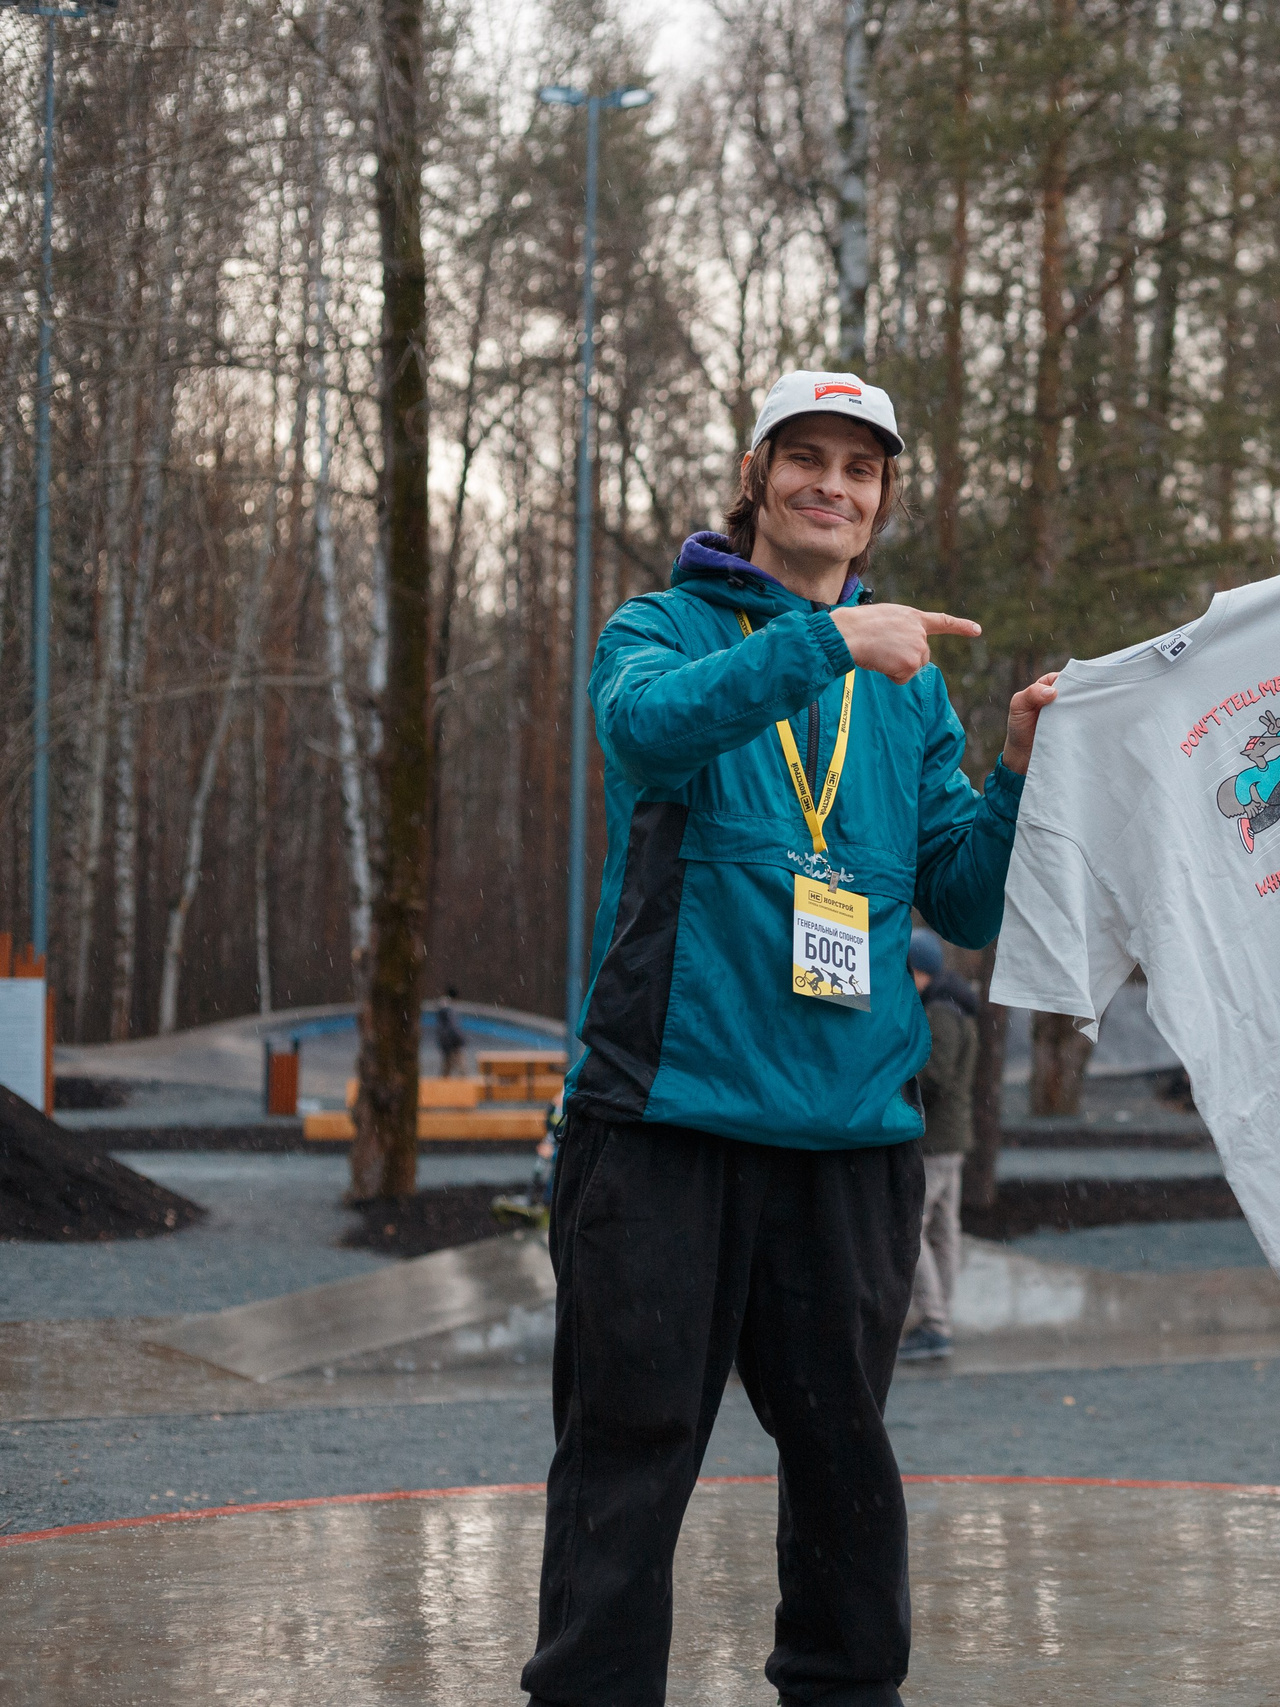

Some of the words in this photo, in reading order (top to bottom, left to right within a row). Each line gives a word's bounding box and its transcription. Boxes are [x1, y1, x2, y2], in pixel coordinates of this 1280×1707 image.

[1180, 706, 1221, 758] DON'T
[1219, 688, 1261, 717] TELL
[790, 762, 807, 796] НОРСТРОЙ
[823, 896, 854, 912] НОРСТРОЙ
[797, 917, 839, 938] ГЕНЕРАЛЬНЫЙ
[839, 930, 864, 945] СПОНСОР
[805, 931, 856, 972] БОСС
